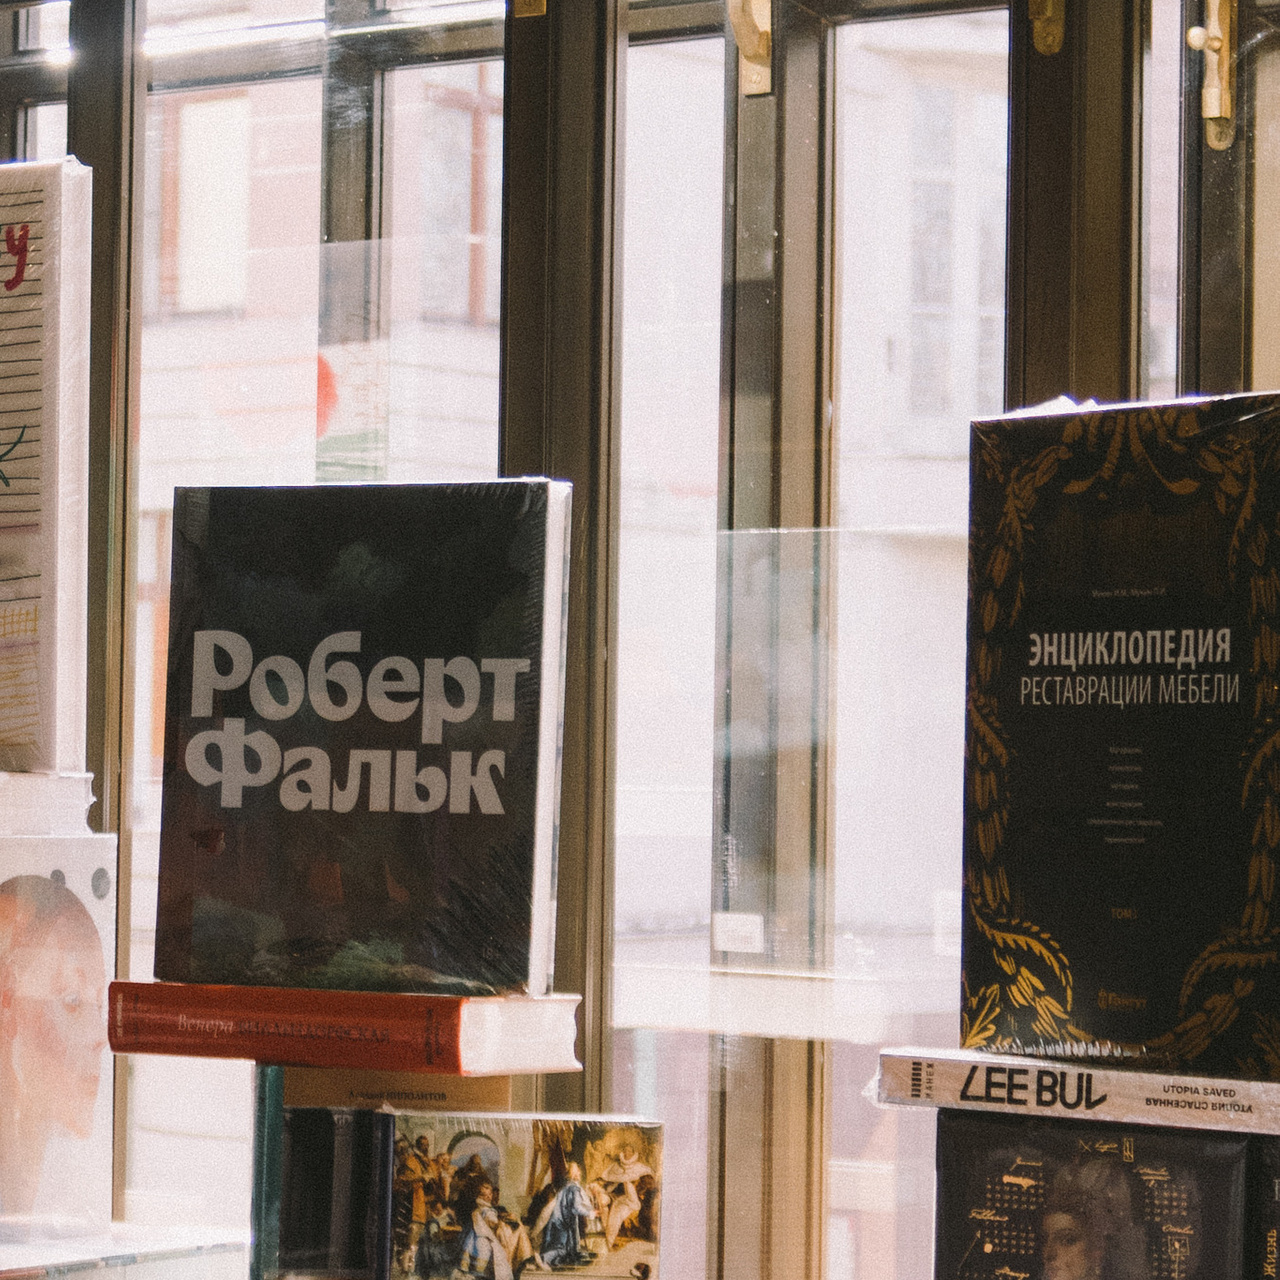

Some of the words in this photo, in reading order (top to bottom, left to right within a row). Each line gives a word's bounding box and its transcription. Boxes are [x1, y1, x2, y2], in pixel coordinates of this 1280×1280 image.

[1029, 628, 1231, 671] ЭНЦИКЛОПЕДИЯ
[191, 630, 531, 744] Роберт
[1021, 675, 1151, 709] РЕСТАВРАЦИИ
[1159, 673, 1239, 704] МЕБЕЛИ
[185, 718, 506, 816] Фальк
[178, 1013, 234, 1038] Венера
[960, 1065, 1028, 1106] LEE
[1036, 1069, 1108, 1110] BUL
[1162, 1084, 1201, 1097] UTOPIA
[1202, 1086, 1237, 1099] SAVED
[1210, 1100, 1253, 1114] УТОПИЯ
[1263, 1228, 1277, 1277] Жизнь
